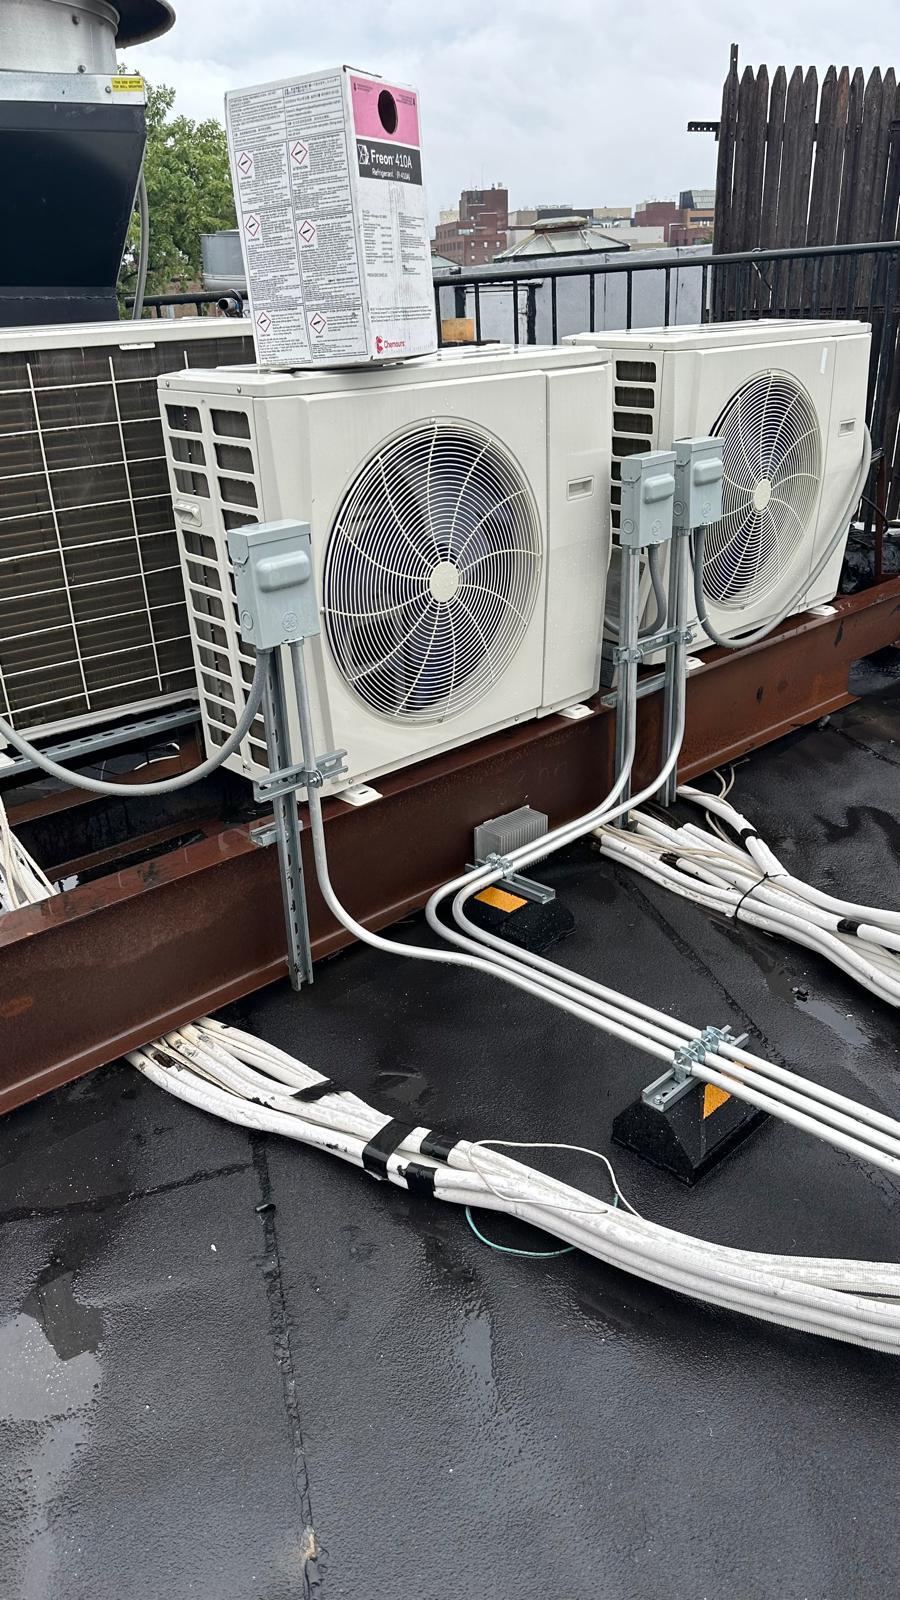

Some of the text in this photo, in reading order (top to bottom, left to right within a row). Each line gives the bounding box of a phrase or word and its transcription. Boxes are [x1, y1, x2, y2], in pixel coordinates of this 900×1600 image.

[370, 149, 413, 169] Freon 410A
[372, 167, 394, 178] Refrigerant
[383, 340, 405, 349] Chemours
